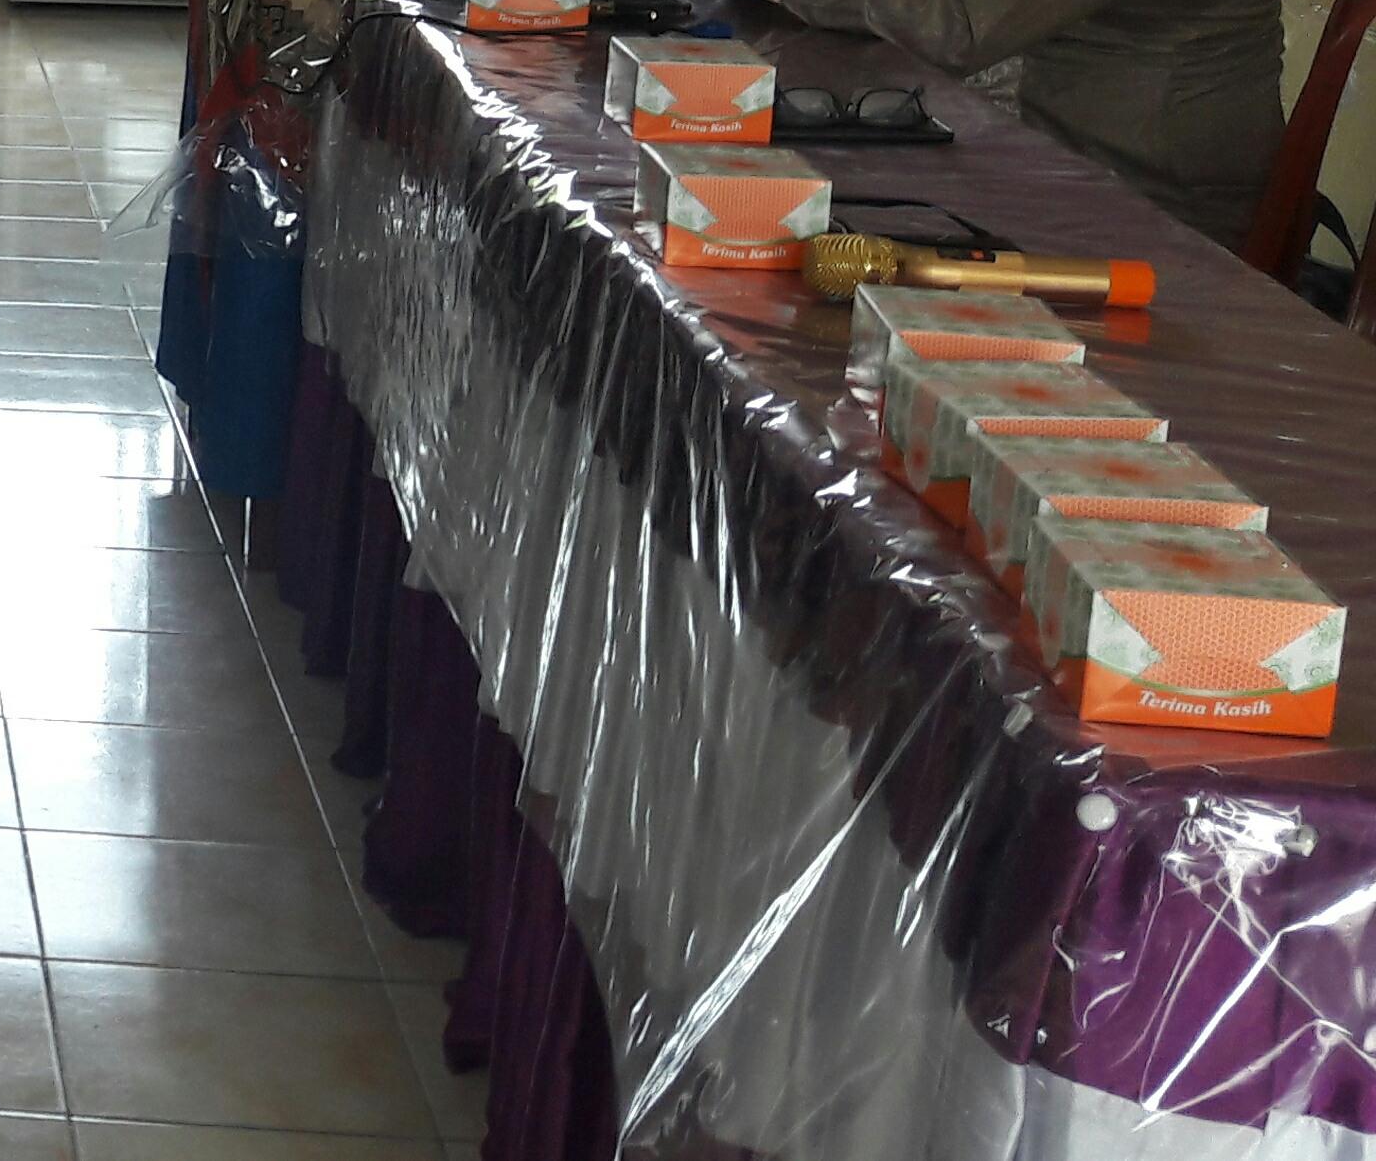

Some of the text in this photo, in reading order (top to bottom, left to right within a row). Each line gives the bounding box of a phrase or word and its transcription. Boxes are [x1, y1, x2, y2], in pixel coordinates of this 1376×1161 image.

[748, 246, 786, 259] Kasih
[1138, 690, 1272, 717] Terima Kasih
